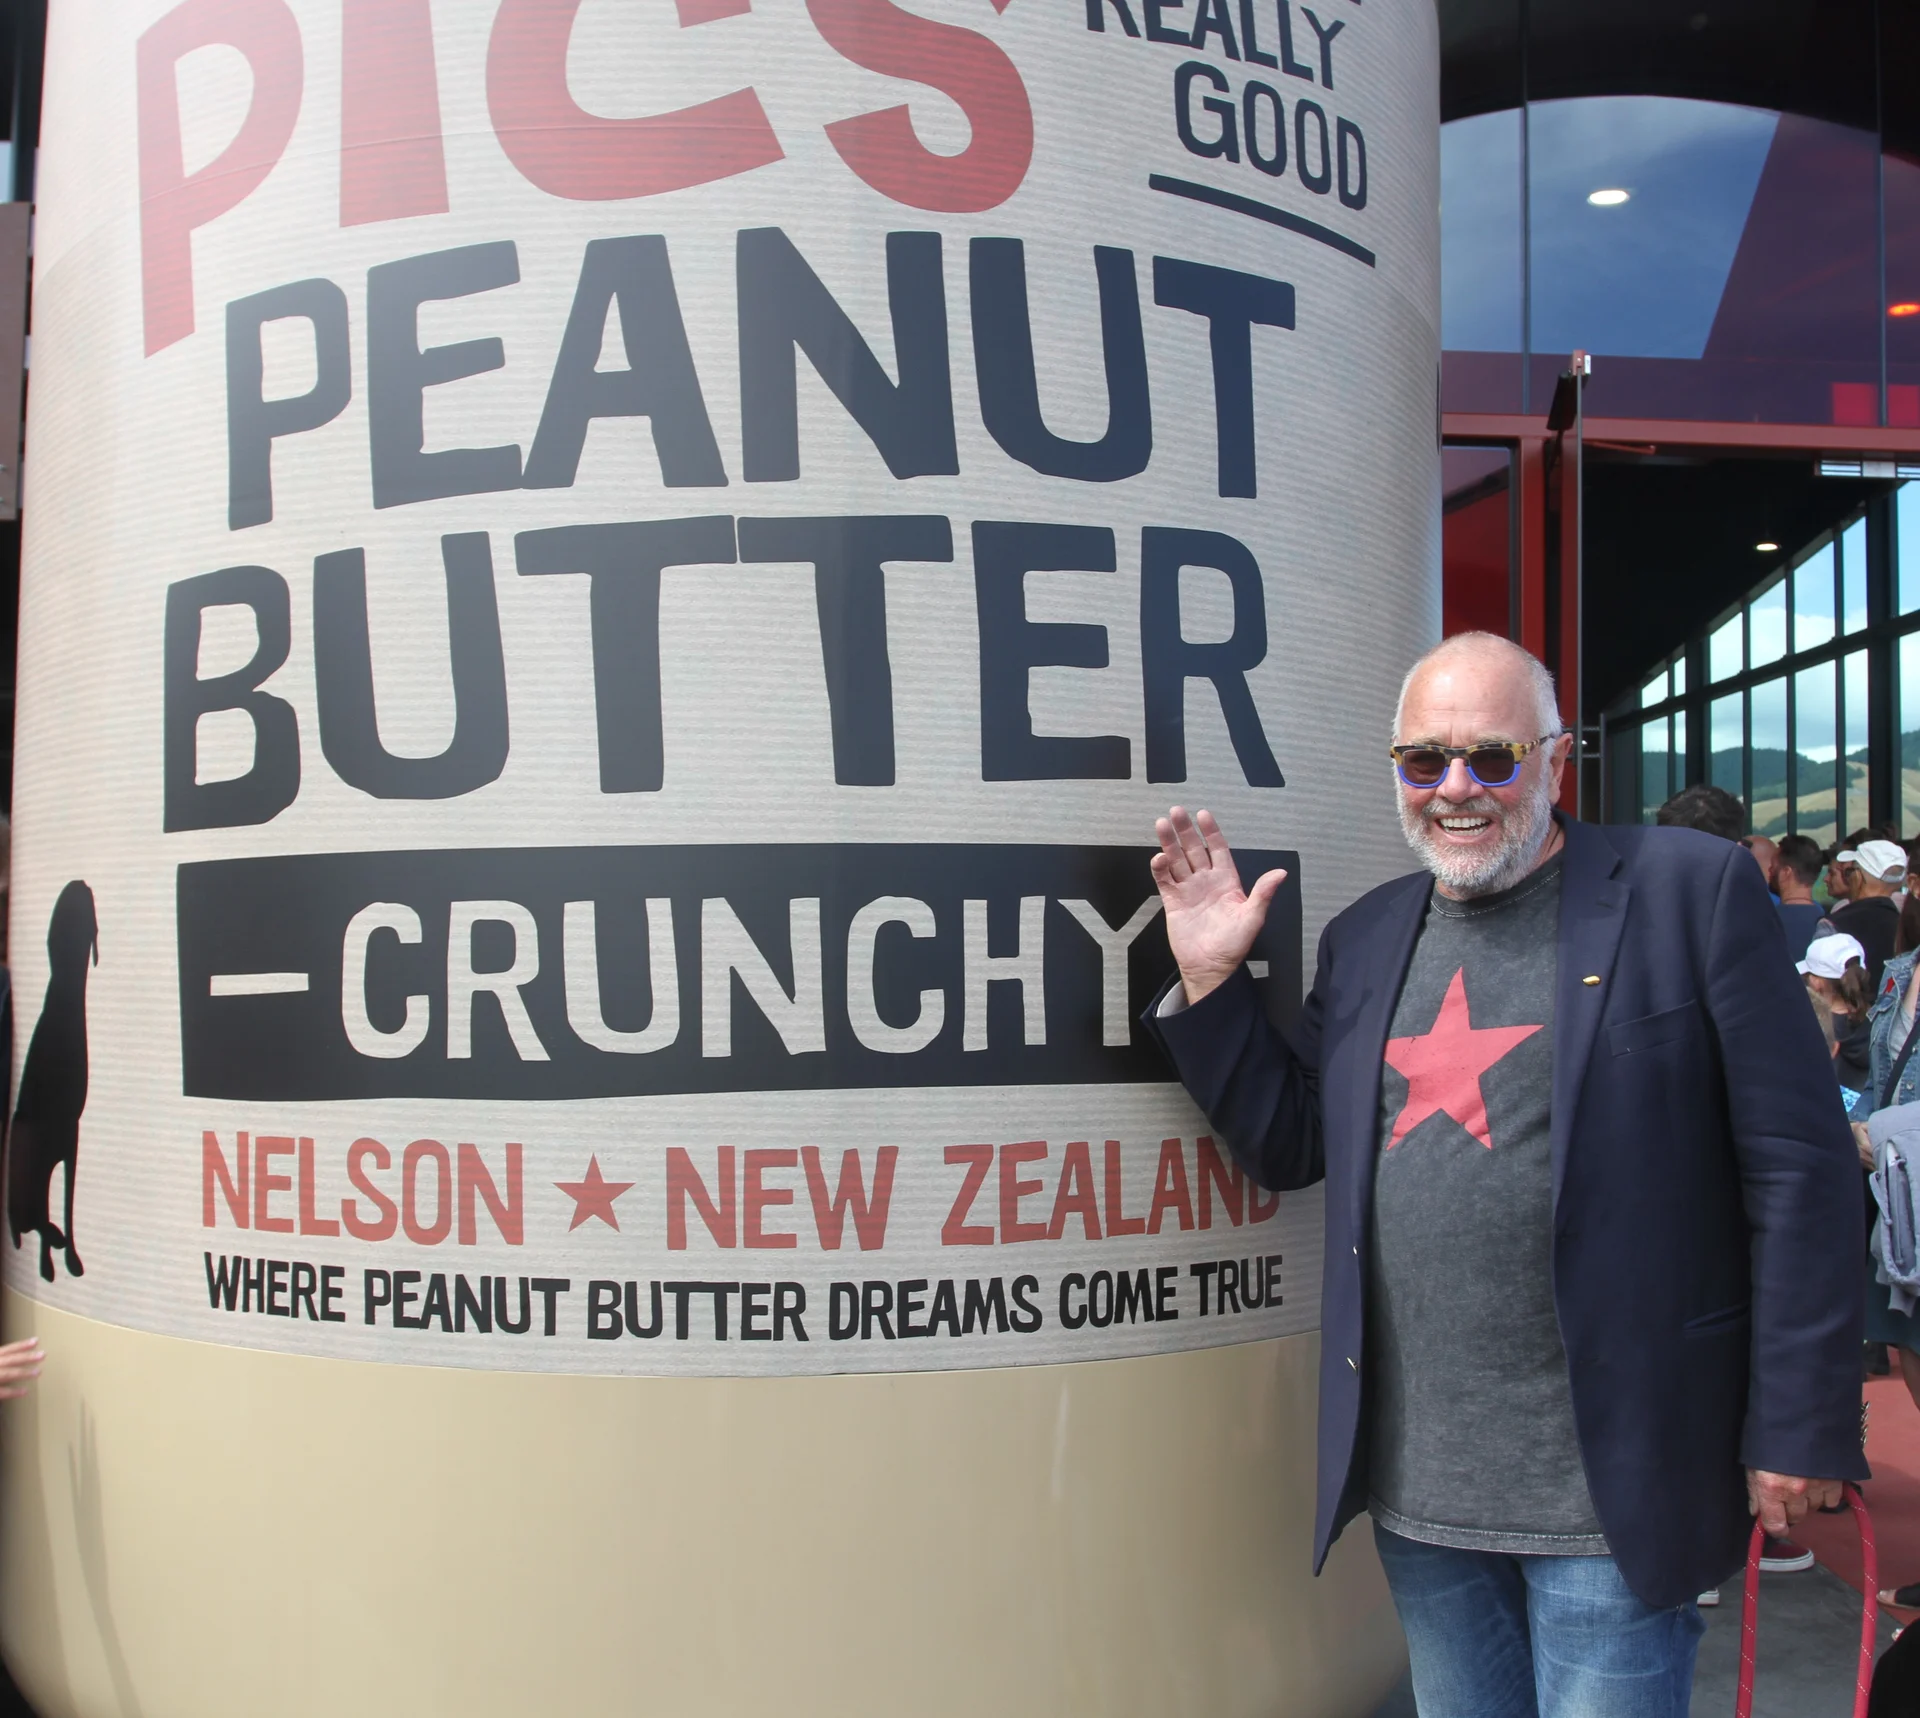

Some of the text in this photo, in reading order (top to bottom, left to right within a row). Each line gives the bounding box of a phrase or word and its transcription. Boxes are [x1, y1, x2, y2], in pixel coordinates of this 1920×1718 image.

[1174, 60, 1368, 212] GOOD
[225, 226, 1296, 531] PEANUT
[163, 514, 1286, 833] BUTTER
[202, 1130, 524, 1246] NELSON
[666, 1145, 899, 1251] NEW
[203, 1251, 1284, 1342] WHERE PEANUT BUTTER DREAMS COME TRUE
